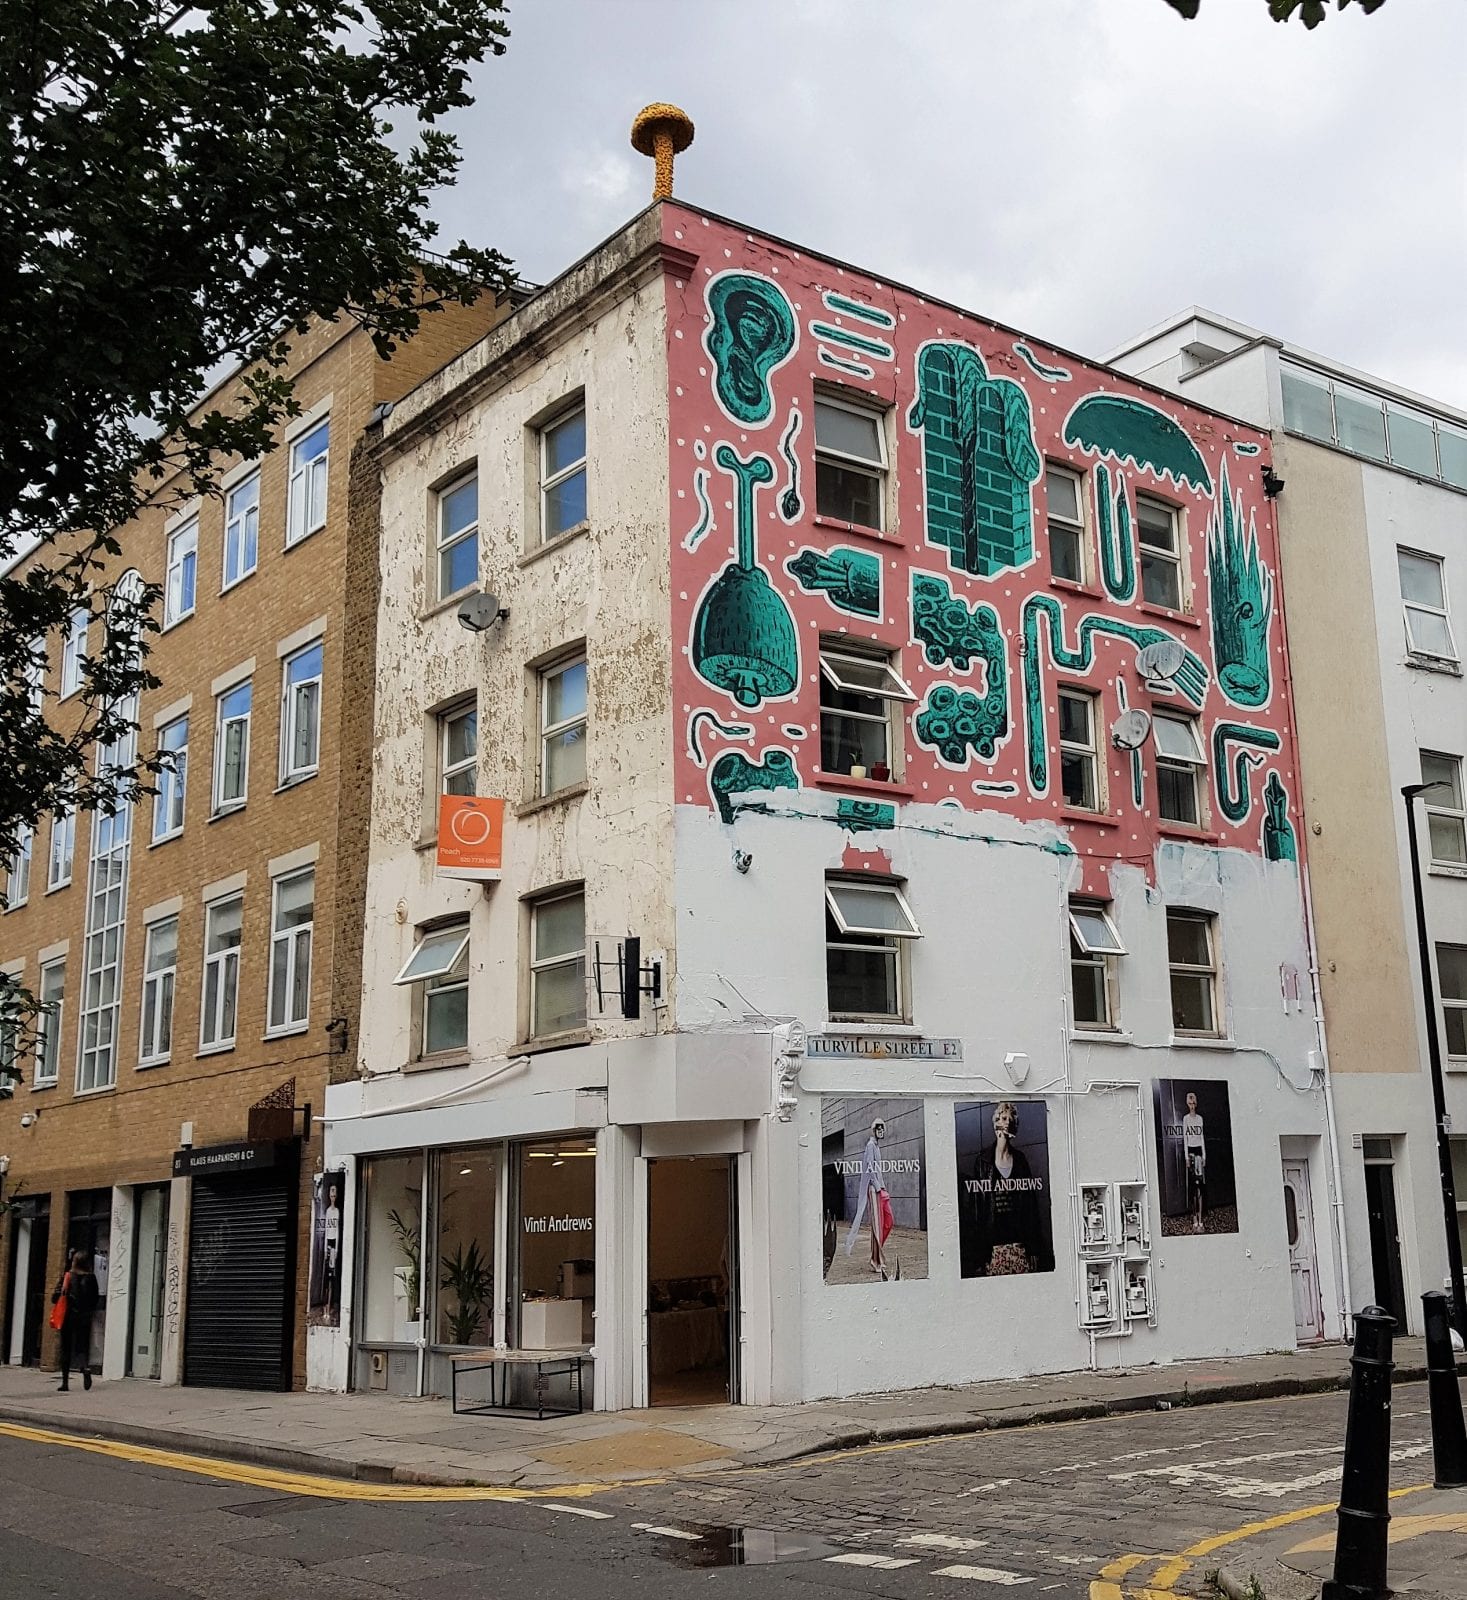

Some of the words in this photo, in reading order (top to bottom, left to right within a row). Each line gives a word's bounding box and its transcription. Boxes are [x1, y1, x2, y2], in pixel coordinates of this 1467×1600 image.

[440, 847, 461, 856] Peach
[813, 1039, 881, 1054] TURVILLE
[885, 1042, 933, 1055] STREET
[944, 1043, 957, 1055] E2
[190, 1156, 207, 1166] KLAUS
[241, 1151, 246, 1160] &
[834, 1161, 863, 1174] VINTI
[865, 1160, 920, 1173] ANDREWS
[965, 1179, 992, 1193] VINTI
[994, 1178, 1043, 1192] ANDREWS
[524, 1216, 546, 1232] Vinti
[548, 1214, 593, 1232] Andrews
